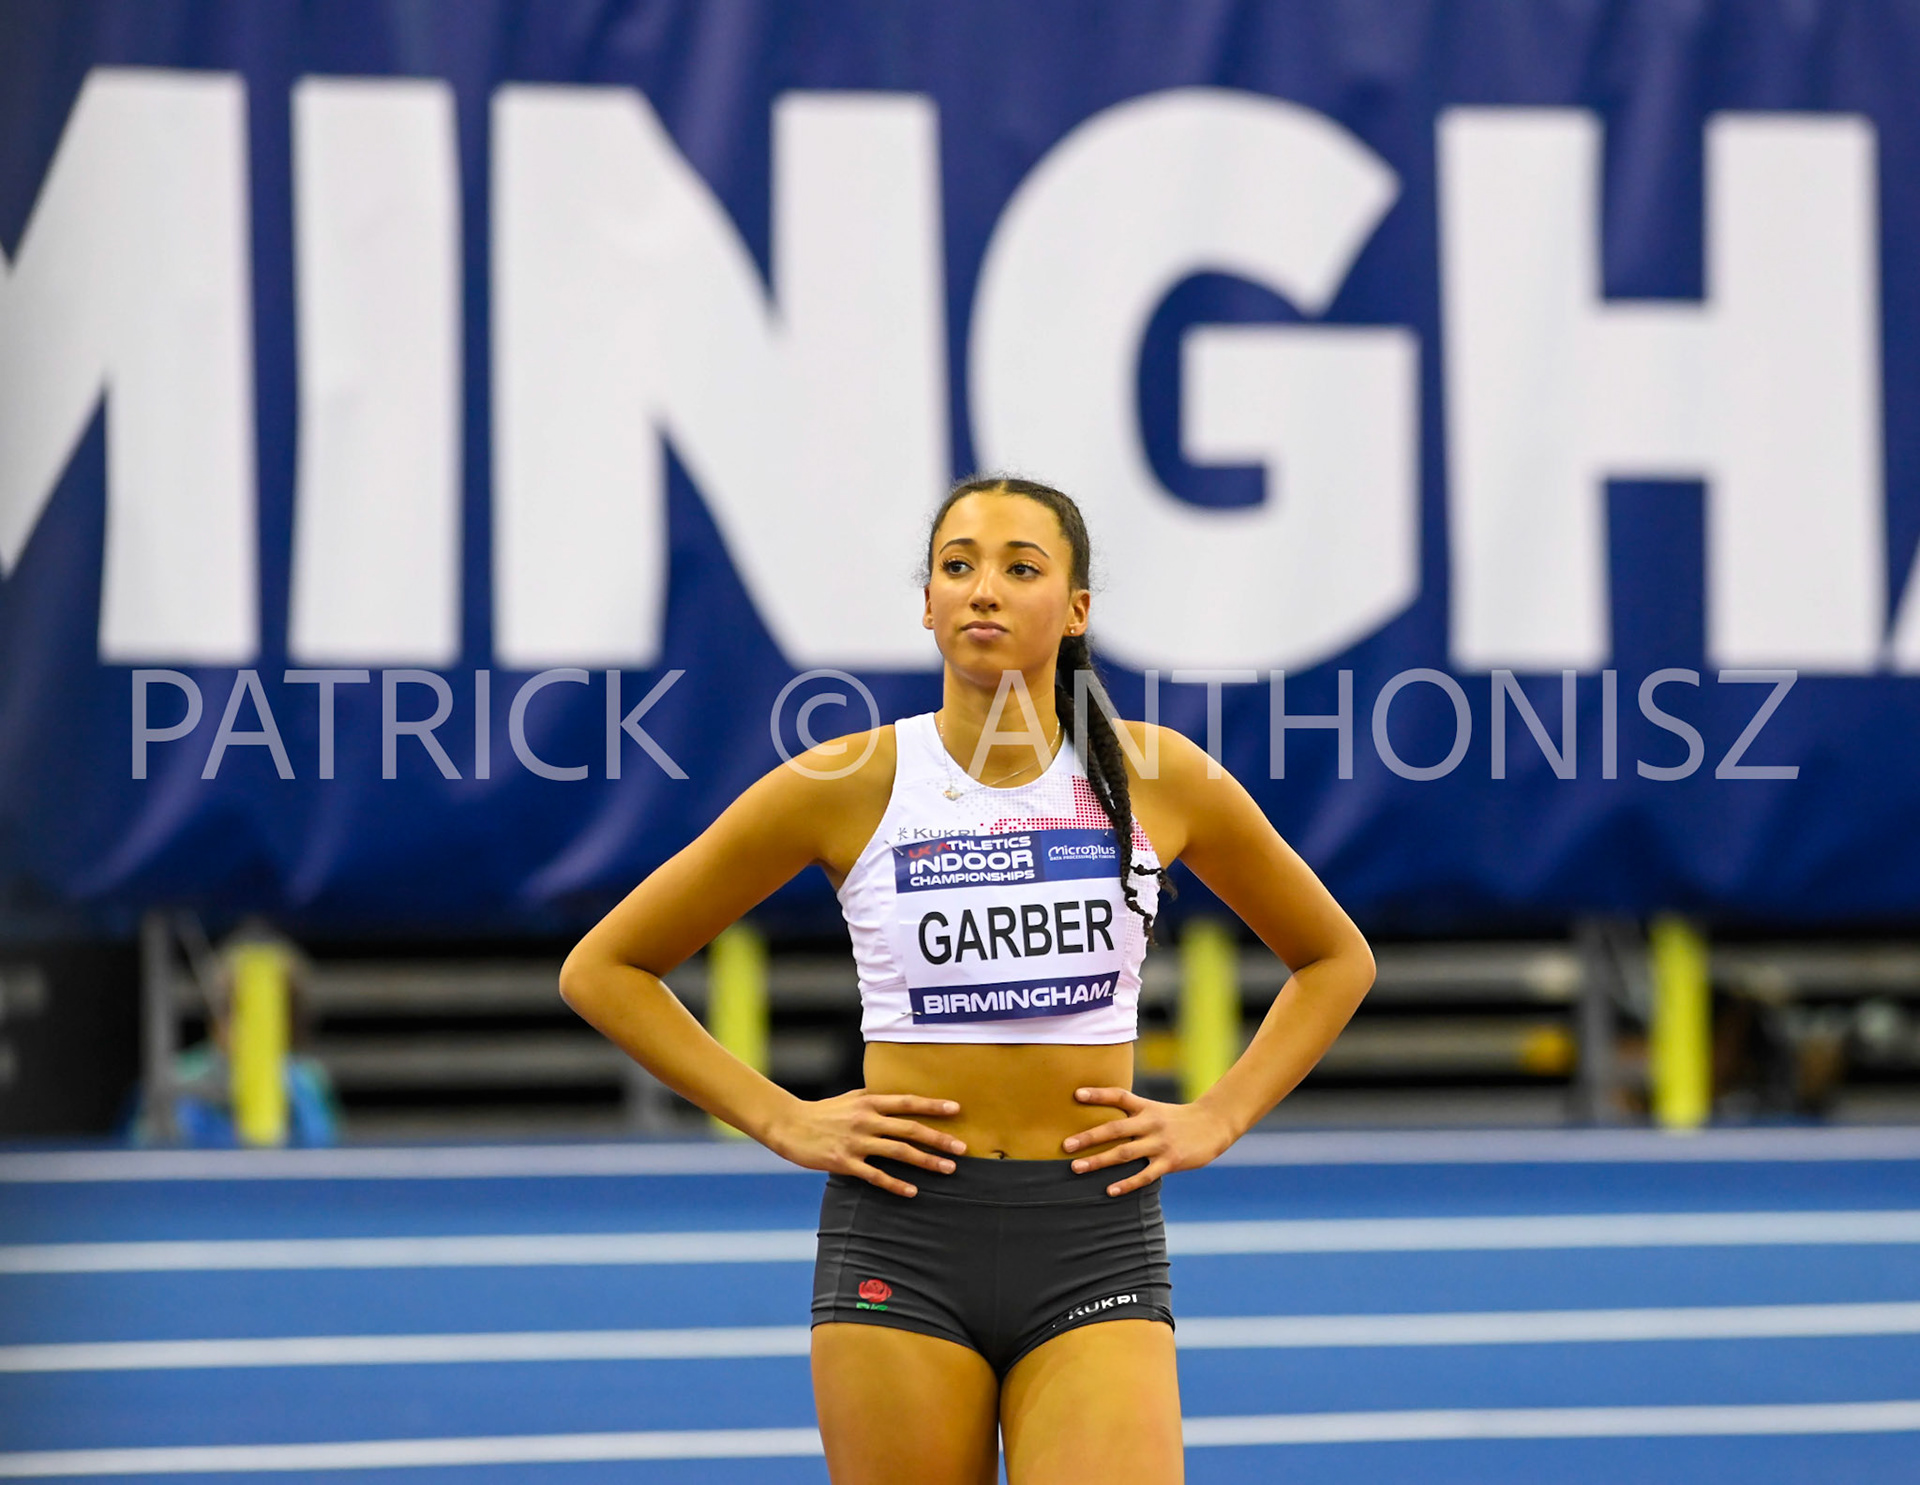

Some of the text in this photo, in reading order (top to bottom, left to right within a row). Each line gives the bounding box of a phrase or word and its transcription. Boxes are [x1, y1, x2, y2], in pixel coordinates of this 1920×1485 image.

[909, 849, 1034, 875] INDOOR
[910, 869, 1036, 887] CHAMPIONSHIPS
[918, 899, 1115, 965] GARBER
[922, 980, 1111, 1015] BIRMINGHAM
